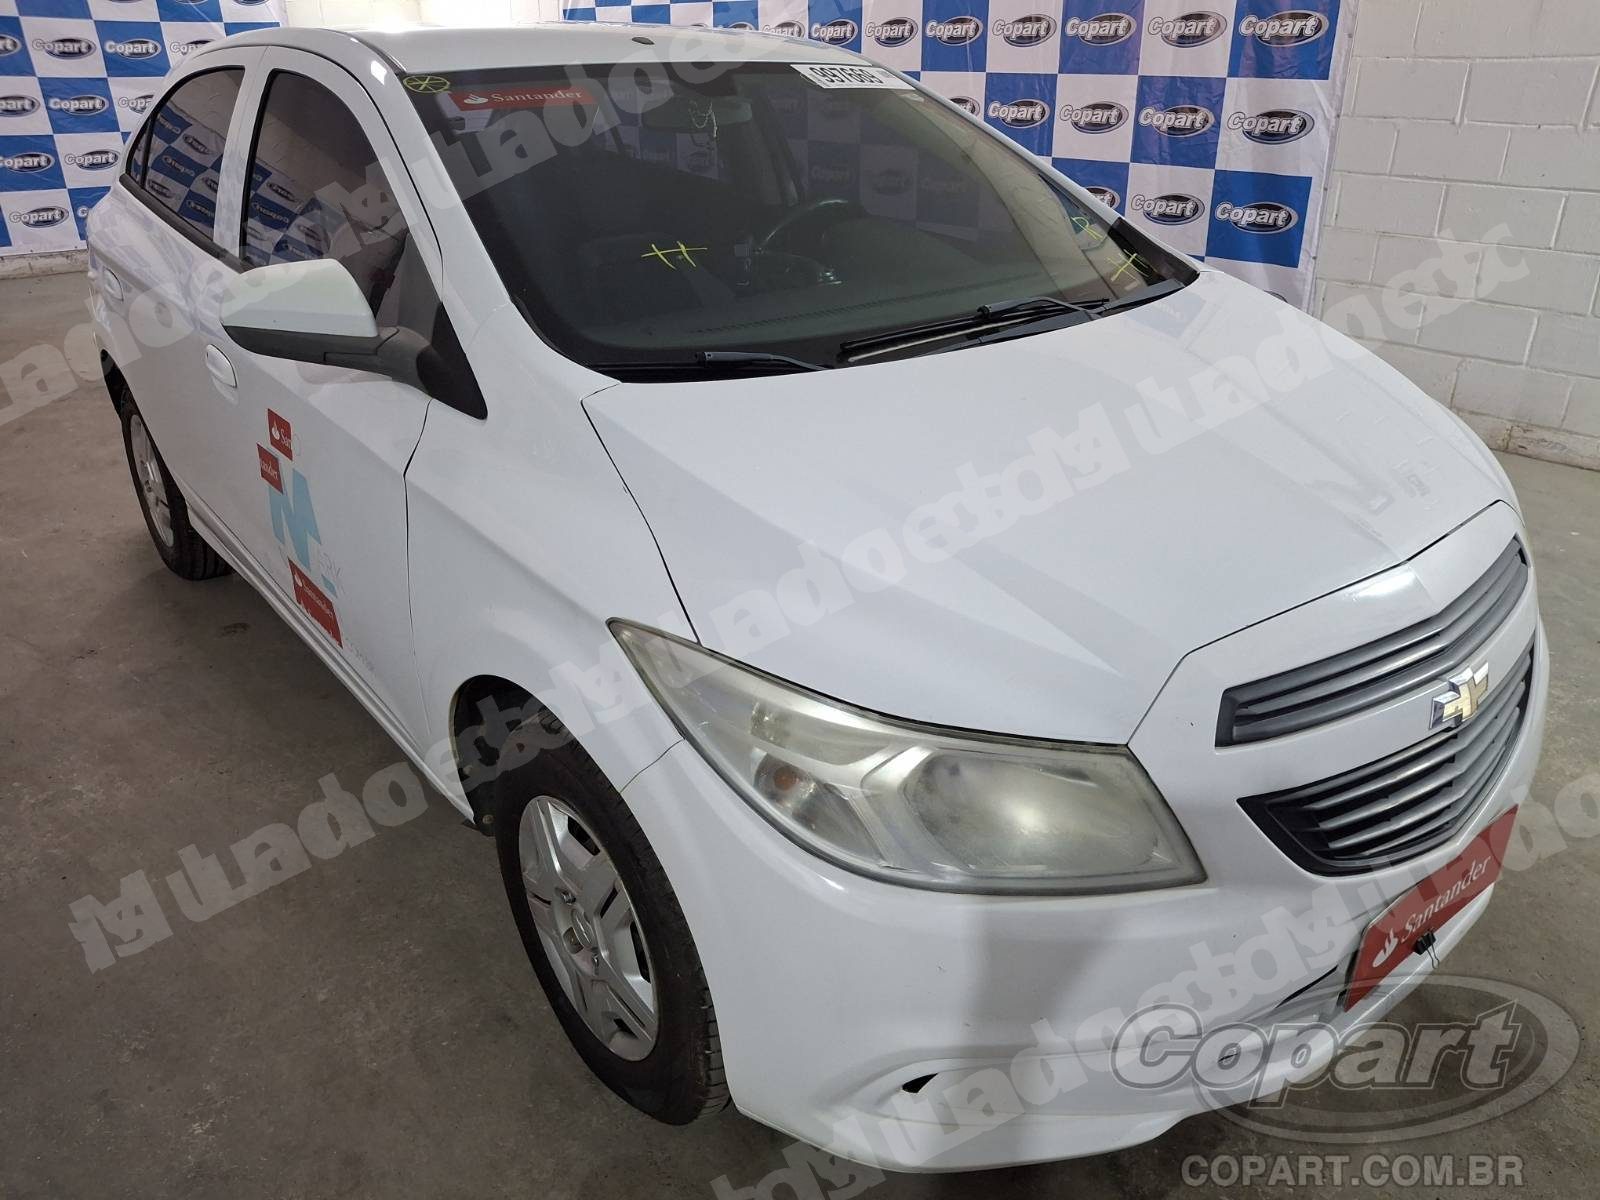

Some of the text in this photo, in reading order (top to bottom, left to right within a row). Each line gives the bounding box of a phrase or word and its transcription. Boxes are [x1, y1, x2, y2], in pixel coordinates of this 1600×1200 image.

[811, 23, 854, 40] Copart
[865, 21, 912, 39] Copart
[925, 20, 977, 39] Copart
[992, 19, 1048, 40] Copart
[1065, 17, 1132, 40] Copart
[1148, 17, 1219, 40] Copart
[1239, 15, 1319, 40] Copart
[32, 39, 90, 55] Copart
[105, 40, 154, 55] Copart
[808, 66, 884, 84] 997669
[0, 97, 34, 114] part
[118, 97, 151, 113] Copa
[491, 90, 584, 102] Santander
[50, 98, 103, 114] Copart
[988, 101, 1043, 120] Copart
[1060, 104, 1119, 124] Copart
[1138, 107, 1205, 130] Copart
[1227, 112, 1303, 135] Copart
[65, 152, 116, 168] Copart
[1131, 194, 1196, 217] Copart
[1215, 202, 1289, 227] Copart
[9, 208, 63, 224] Copart
[1401, 856, 1492, 943] Santander
